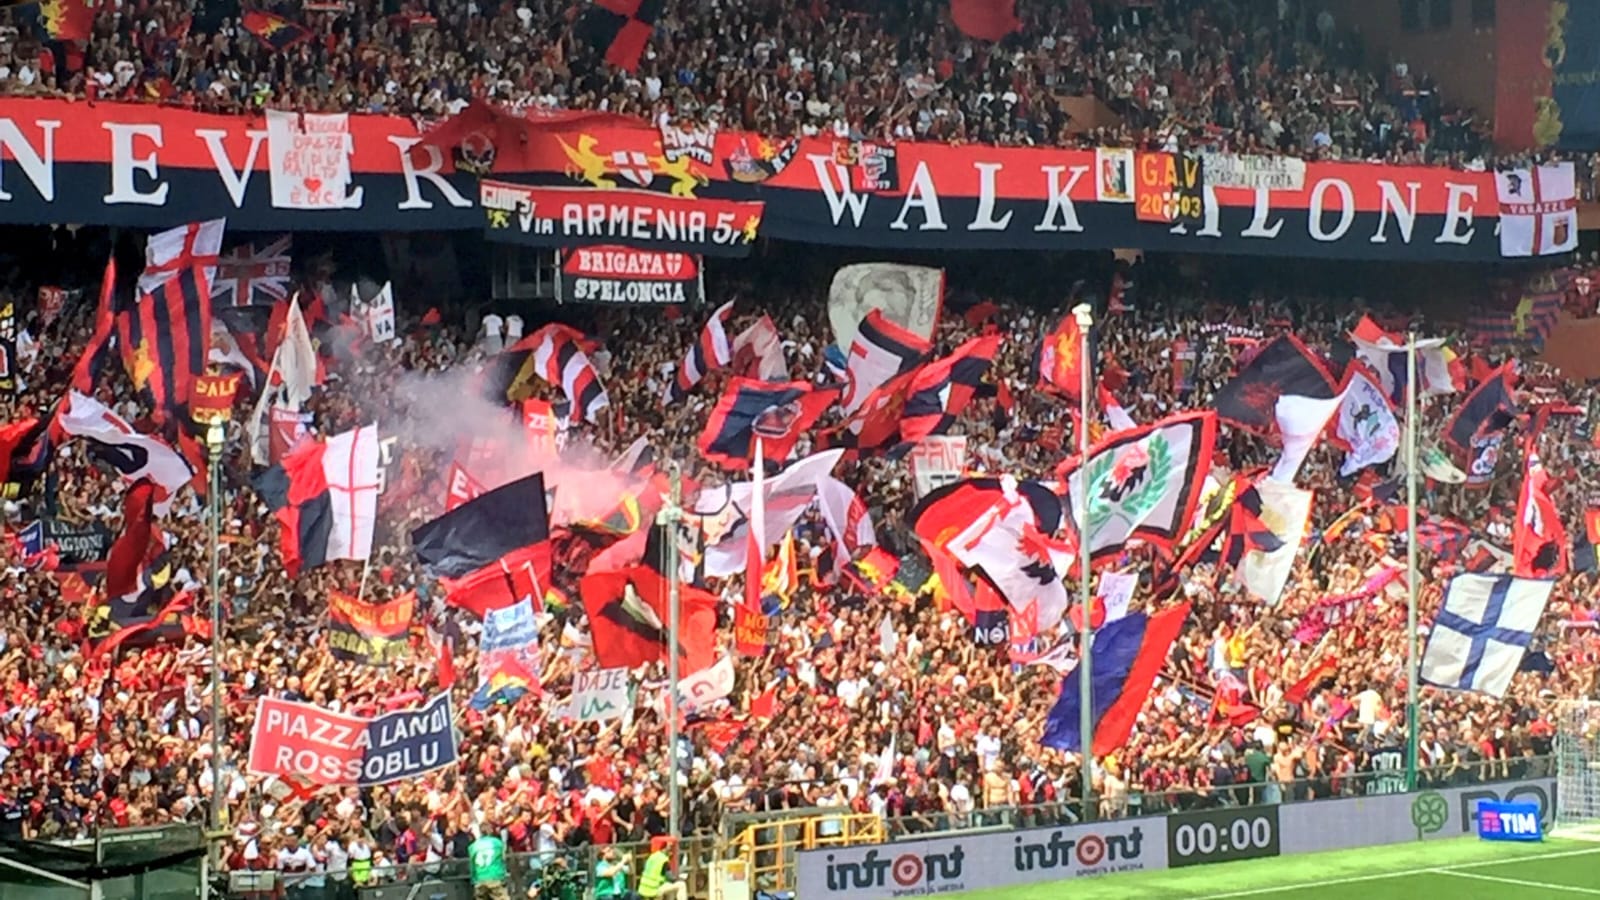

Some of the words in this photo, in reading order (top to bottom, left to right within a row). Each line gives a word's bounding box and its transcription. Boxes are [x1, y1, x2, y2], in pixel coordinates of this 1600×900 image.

[805, 153, 1088, 231] WALK
[518, 202, 554, 234] VIA
[563, 203, 705, 244] ARMENIA
[578, 250, 665, 275] BRIGATA
[574, 278, 686, 302] SPELONCIA
[265, 709, 373, 750] PIAZZA
[380, 704, 449, 747] LANDI
[275, 742, 440, 781] ROSSOBLU
[1176, 816, 1271, 856] 00:00
[1500, 812, 1537, 834] TIM
[827, 845, 964, 891] infront
[1015, 826, 1143, 871] infront
